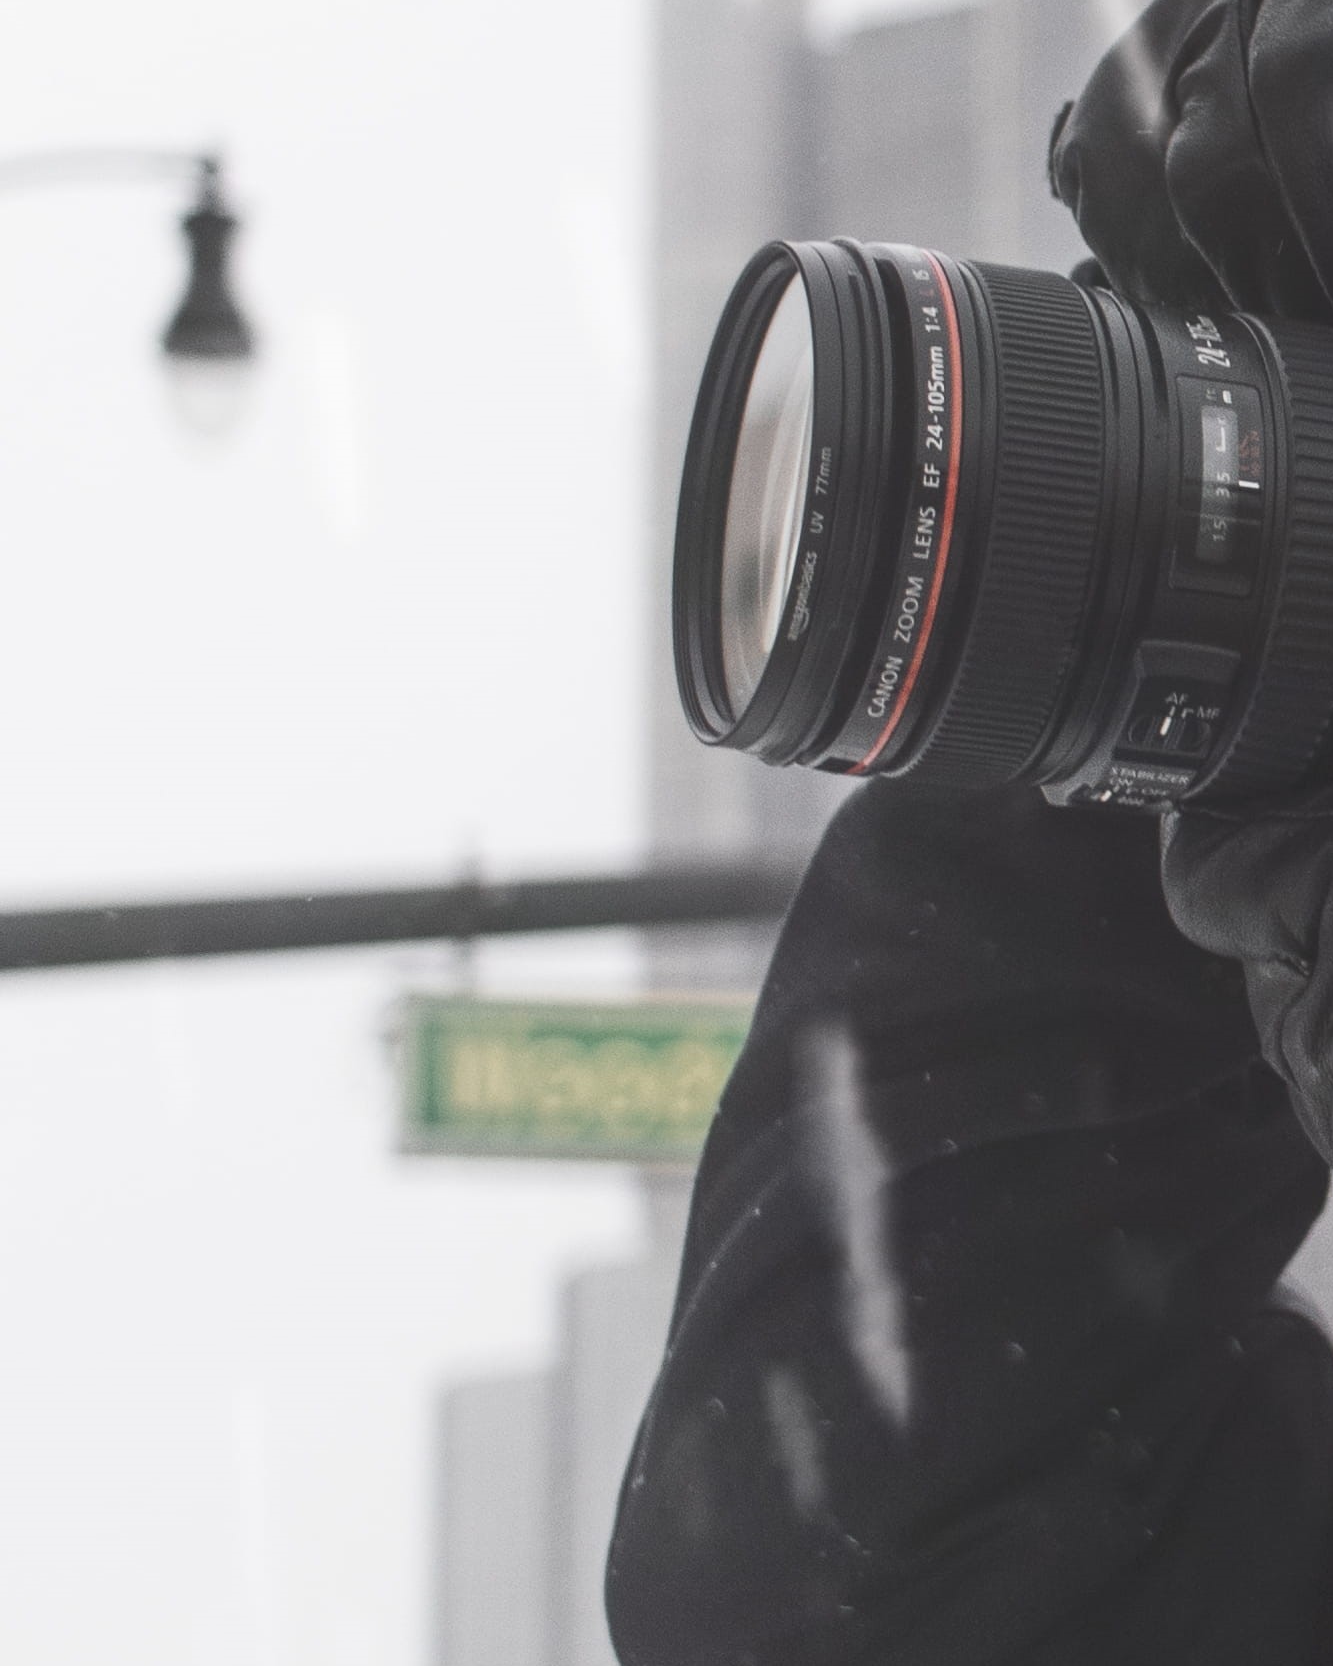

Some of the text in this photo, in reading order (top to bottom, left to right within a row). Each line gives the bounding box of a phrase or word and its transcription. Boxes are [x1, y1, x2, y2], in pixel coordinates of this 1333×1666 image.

[924, 305, 941, 333] 1:4
[926, 344, 945, 452] 24-105mm
[815, 446, 832, 495] 77mm
[923, 462, 941, 489] EF
[809, 510, 824, 535] UV
[913, 506, 936, 560] LENS
[894, 575, 924, 643] ZOOM
[867, 655, 903, 718] CANON
